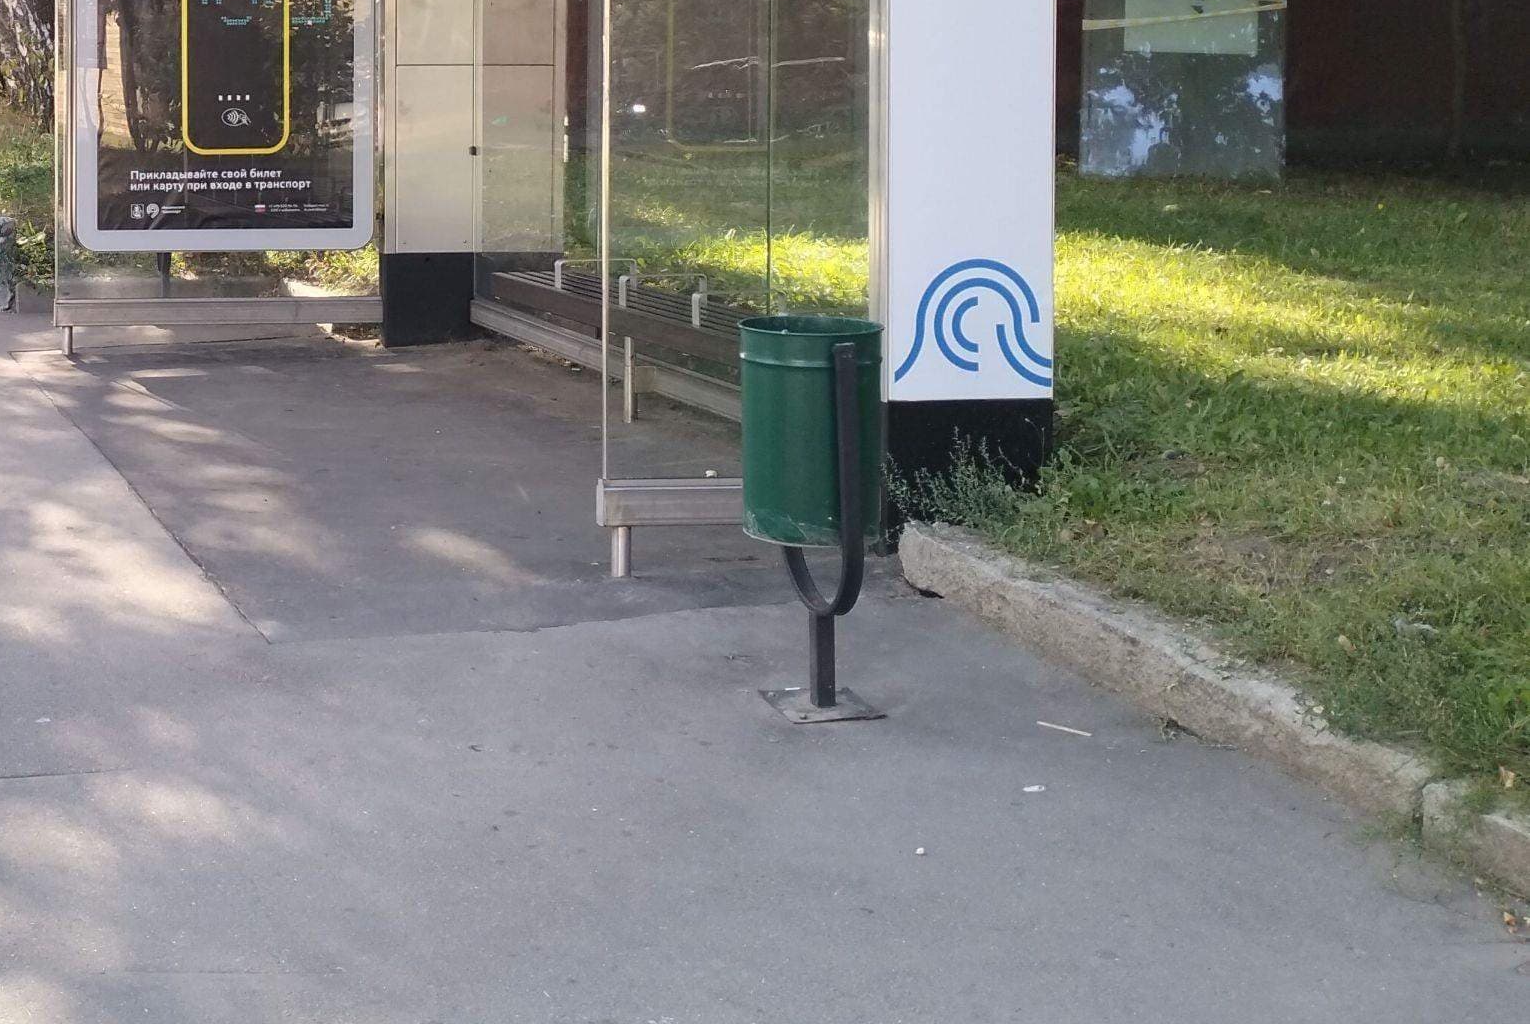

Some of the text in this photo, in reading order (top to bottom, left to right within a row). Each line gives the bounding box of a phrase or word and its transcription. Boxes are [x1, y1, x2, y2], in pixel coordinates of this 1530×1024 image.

[130, 168, 282, 181] Прикладывайте свой билет
[130, 180, 311, 192] или карту при входе в транспорт
